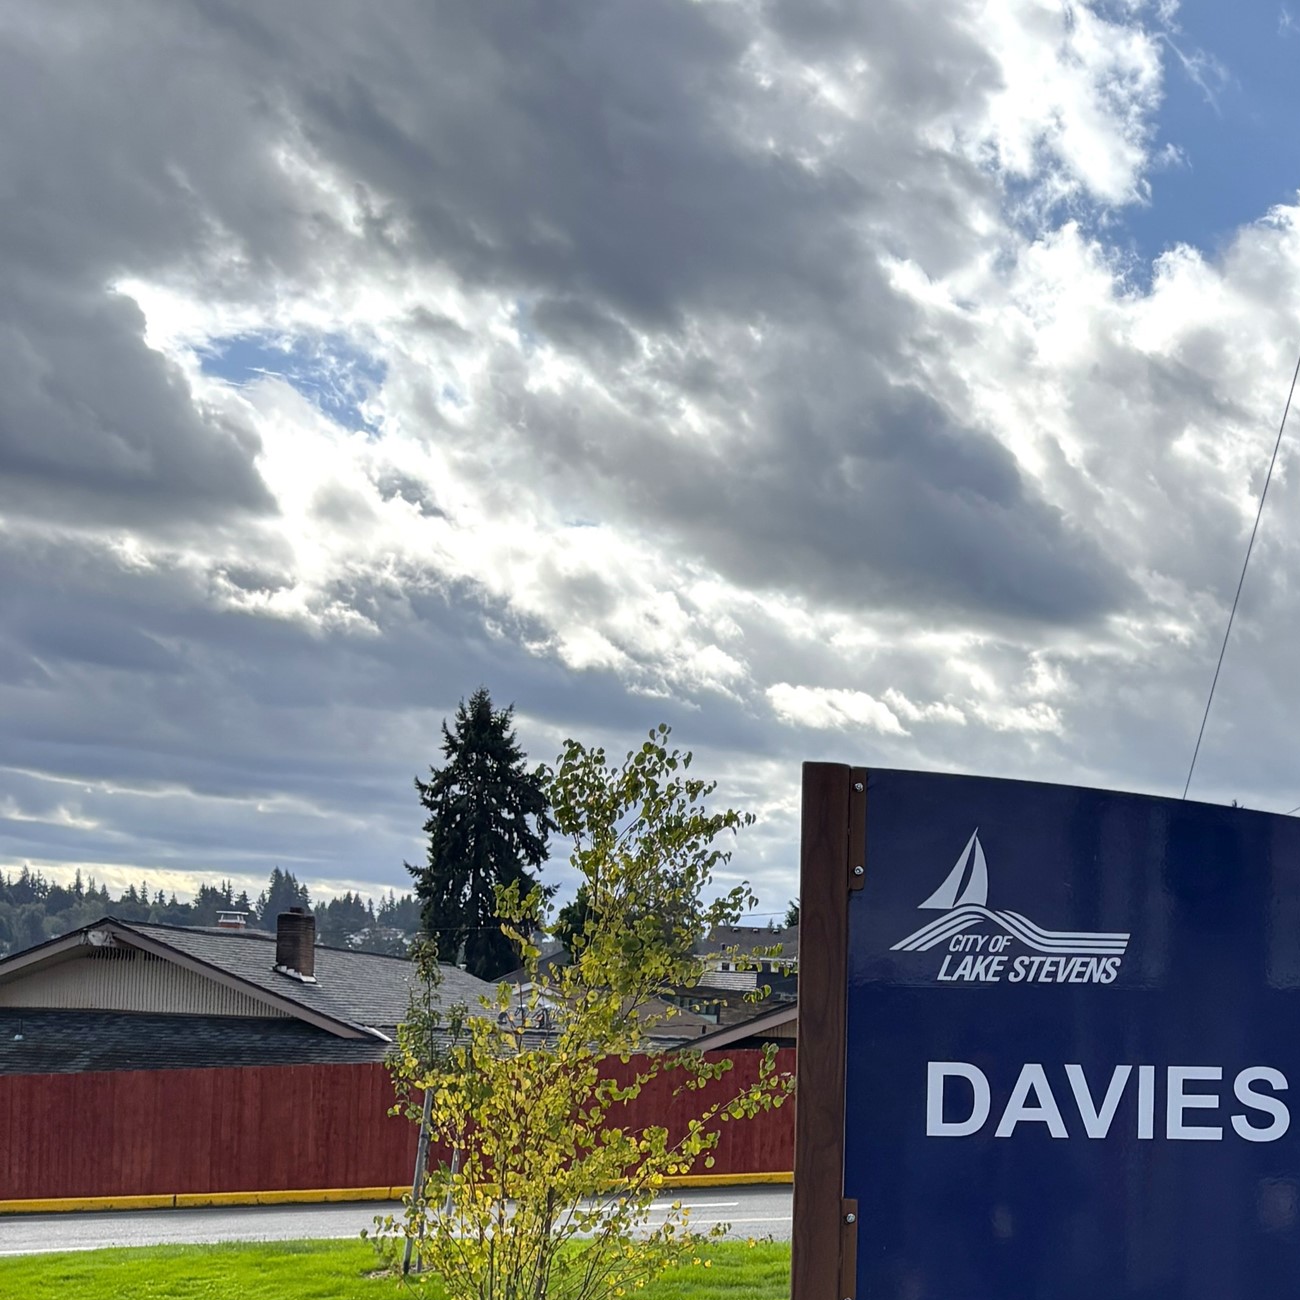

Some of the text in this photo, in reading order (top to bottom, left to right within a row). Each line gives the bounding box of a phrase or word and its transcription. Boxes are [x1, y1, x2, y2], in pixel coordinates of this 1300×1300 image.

[949, 935, 1013, 952] CITY OF
[937, 955, 1121, 984] LAKE STEVENS
[927, 1062, 1290, 1142] DAVIES
